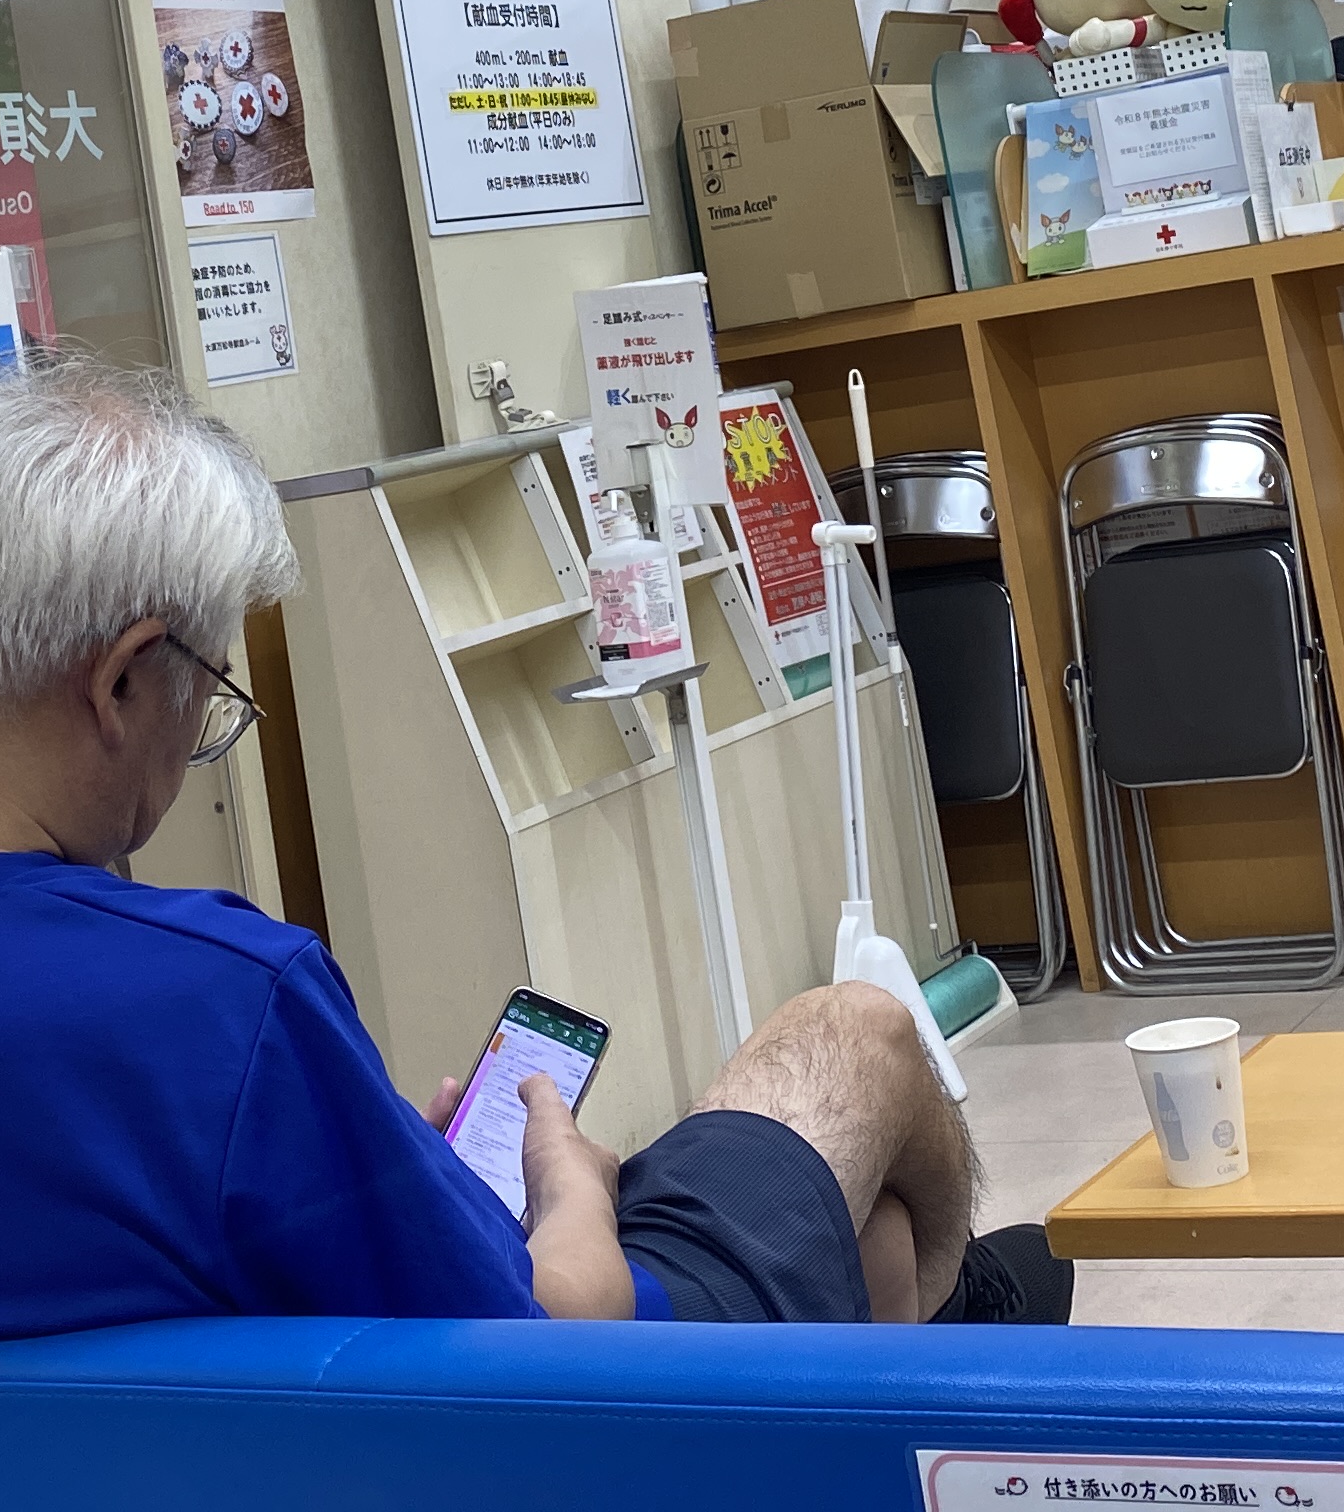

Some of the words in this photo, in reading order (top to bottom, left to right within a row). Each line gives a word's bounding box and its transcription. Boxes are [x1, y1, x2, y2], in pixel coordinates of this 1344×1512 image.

[463, 1, 561, 29] 【献血受付時間】
[549, 49, 569, 66] 献血
[822, 99, 866, 112] TERUMO
[239, 200, 254, 214] 150
[708, 205, 741, 220] Trima
[597, 350, 694, 370] 薬液が飛び出します
[1044, 1476, 1257, 1505] 付き添いの方へのお願い
